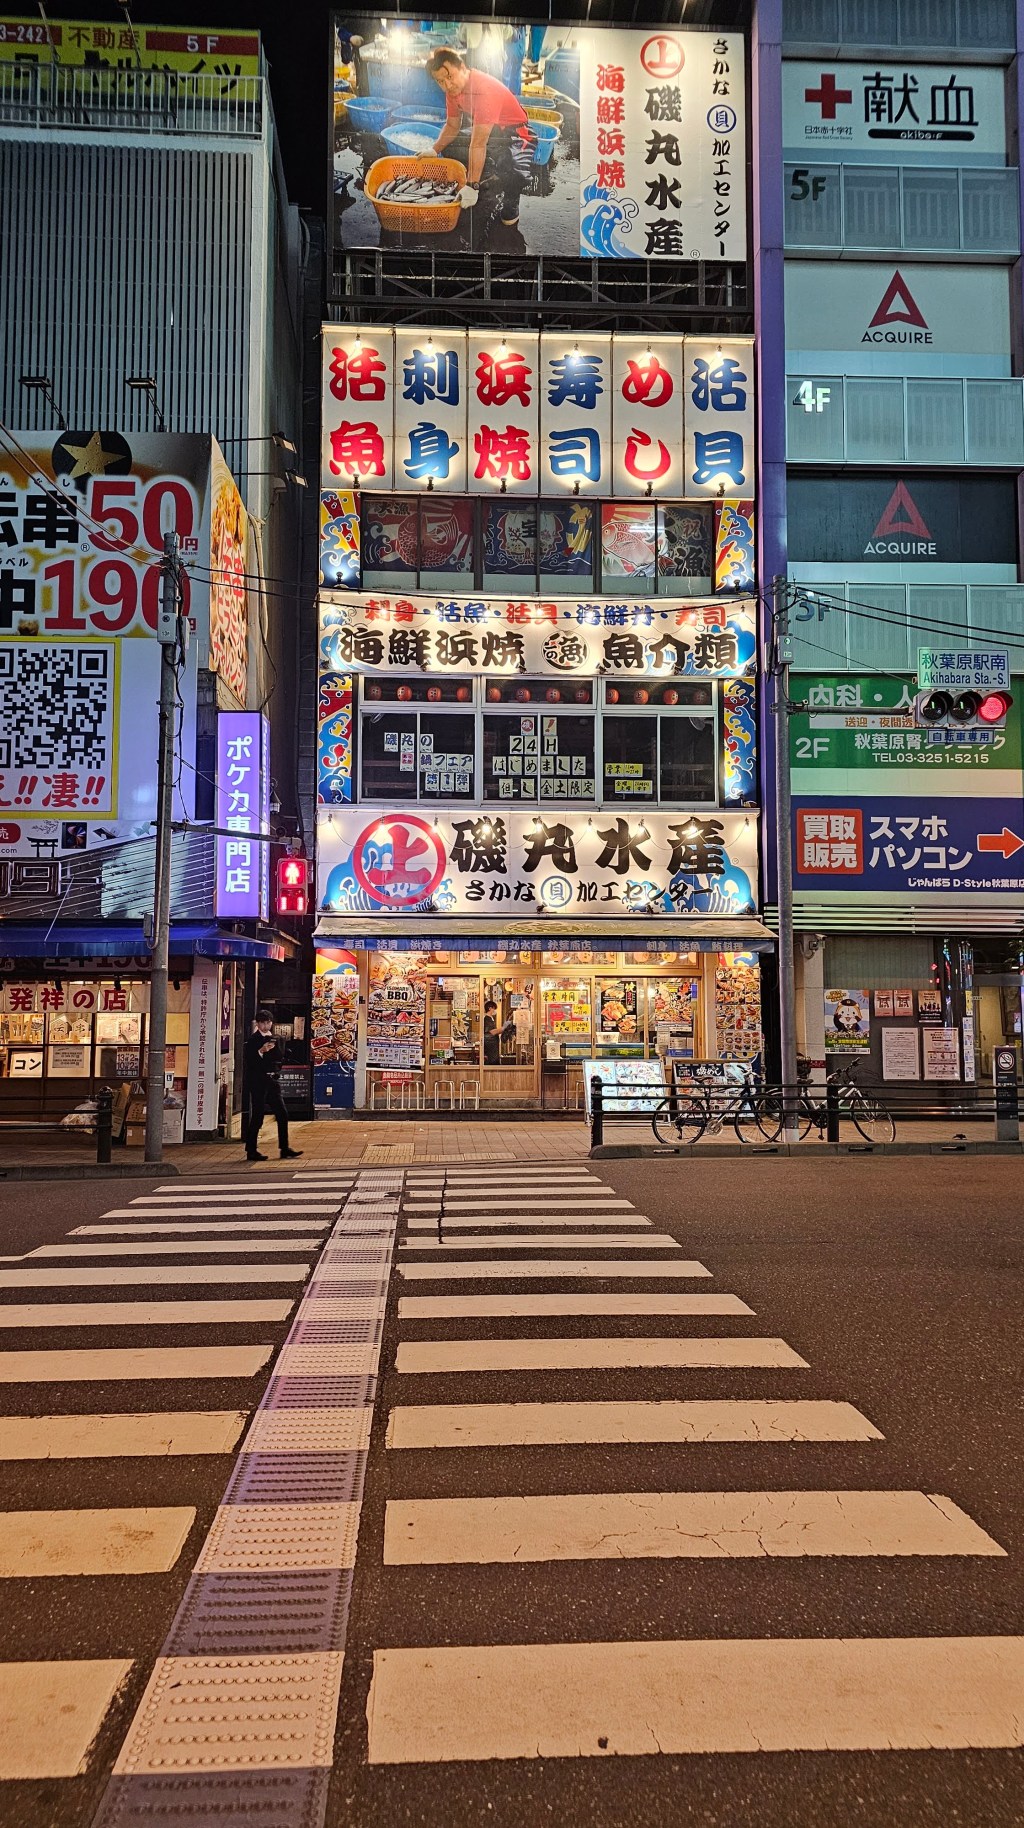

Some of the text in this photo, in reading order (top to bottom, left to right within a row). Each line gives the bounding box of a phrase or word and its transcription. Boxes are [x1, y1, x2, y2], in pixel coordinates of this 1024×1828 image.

[68, 26, 140, 50] 不動産
[186, 34, 219, 53] 5F
[862, 71, 979, 127] 献血
[596, 64, 626, 189] 海鮮浜焼
[804, 125, 853, 135] 日本赤十字社
[644, 84, 684, 256] 磯丸水産
[790, 169, 826, 201] 5F
[860, 331, 933, 344] ACQUIRE
[793, 380, 831, 413] 4F
[328, 346, 387, 477] 活魚
[402, 349, 460, 479] 刺身
[473, 352, 533, 481] 浜焼
[548, 354, 604, 483] 寿司
[621, 357, 674, 480] めし
[691, 358, 748, 485] 活貝
[863, 541, 937, 555] ACQUIRE
[796, 590, 832, 622] 3F
[340, 628, 526, 667] 海鮮浜焼
[602, 632, 738, 670] 魚介類
[921, 652, 1007, 671] 秋葉原駅南
[923, 673, 1006, 685] Akihabara Sta.-S.
[511, 737, 557, 753] 24H
[795, 737, 830, 759] 2F
[494, 758, 584, 773] はじめました
[426, 773, 469, 786] 第1弾
[224, 735, 253, 893] ポケカ専門店
[803, 814, 857, 840] 買取
[869, 815, 949, 841] スマホ
[449, 814, 727, 875] 磯丸水産
[803, 842, 858, 869] 販売
[868, 844, 973, 871] パソコン
[497, 939, 542, 951] 磯丸水産
[547, 939, 593, 951] 秋葉原店
[9, 987, 127, 1012] 発祥の店
[387, 990, 409, 1001] BBQ
